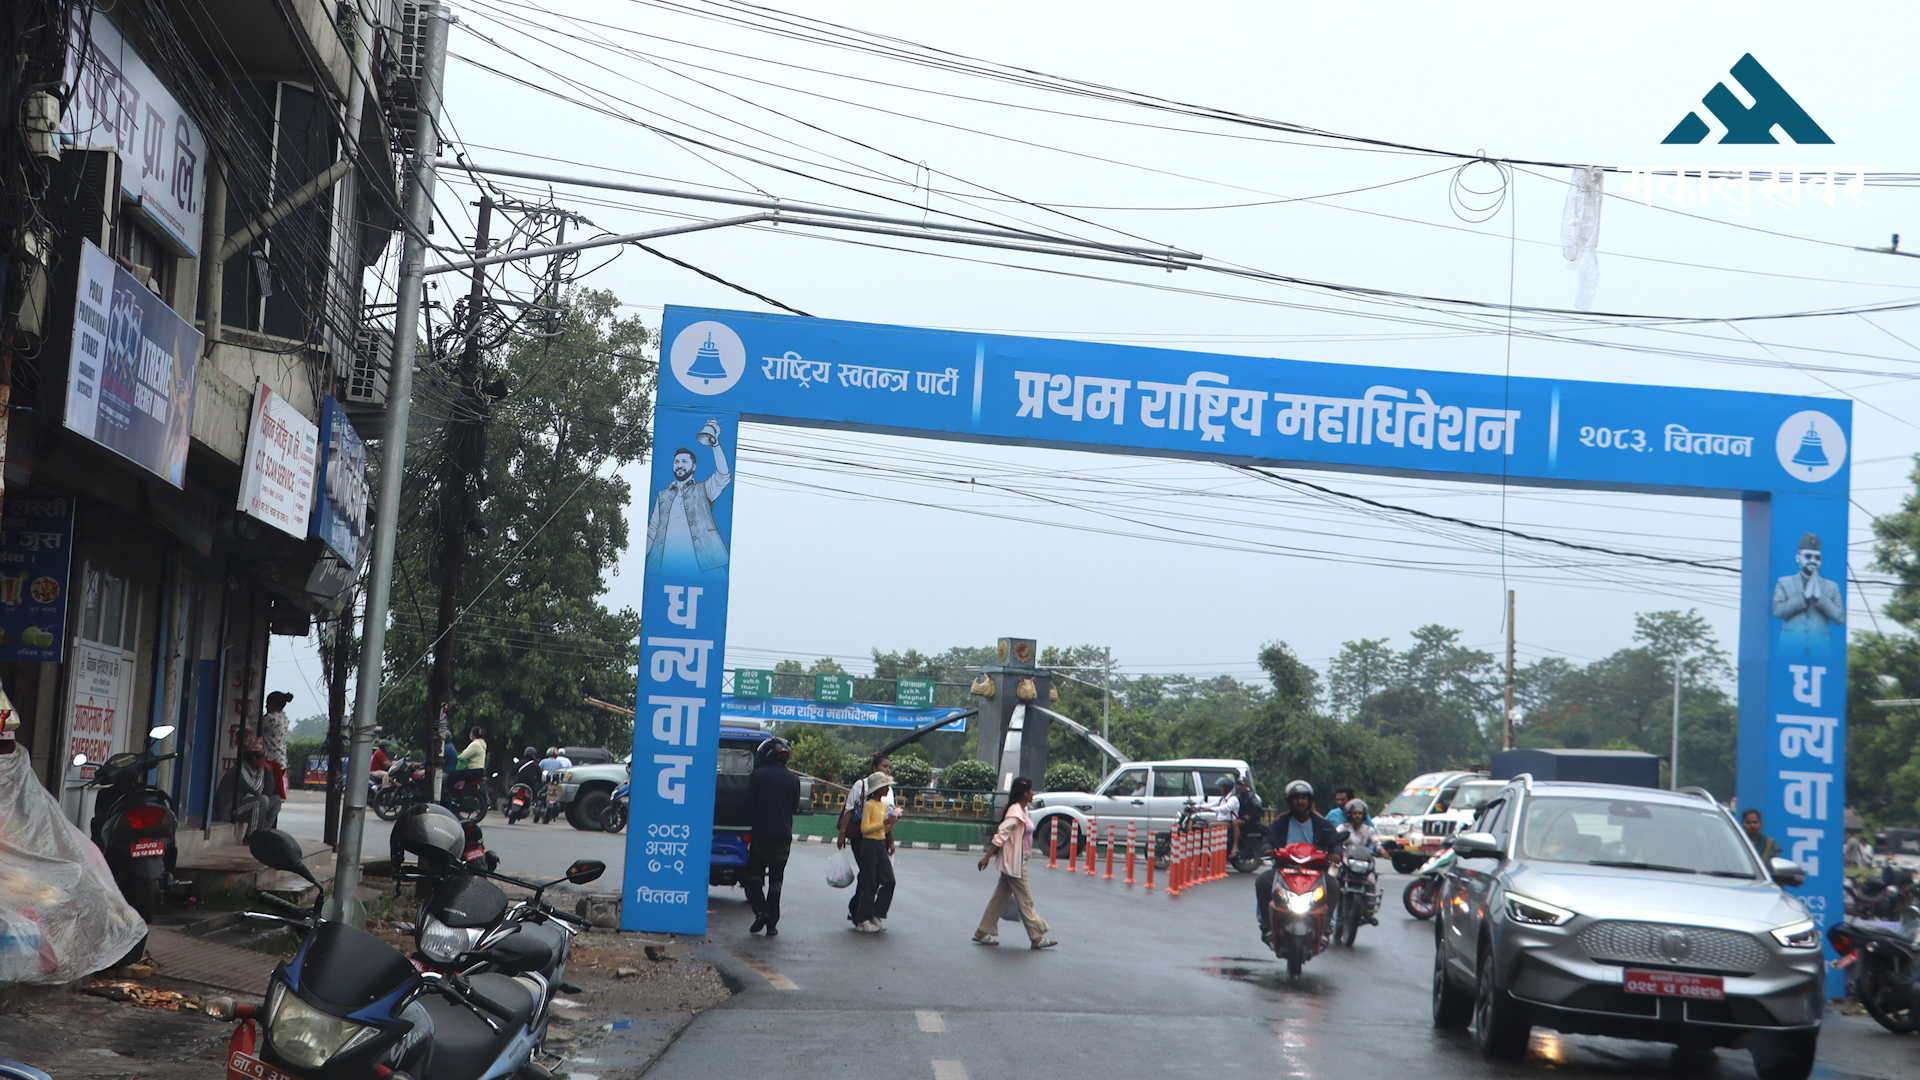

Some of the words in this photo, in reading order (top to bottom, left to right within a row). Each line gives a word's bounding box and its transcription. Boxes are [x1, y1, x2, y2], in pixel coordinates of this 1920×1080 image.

[170, 113, 197, 215] लि.
[78, 300, 108, 337] PROVISIONAL
[81, 333, 100, 360] STORES
[137, 335, 175, 399] XTREME
[762, 351, 831, 389] राष्ट्रिय
[837, 362, 909, 392] स्वतन्त्र
[915, 366, 959, 397] पार्टी
[134, 384, 154, 417] ENERGY
[152, 394, 169, 425] DRINK
[1014, 370, 1129, 425] प्रथम
[1138, 371, 1268, 443] राष्ट्रिय
[1274, 385, 1521, 456] महाधिवेशन
[1663, 423, 1754, 457] चितवन
[266, 455, 277, 486] SCAN
[276, 462, 296, 494] SERVICE
[10, 497, 69, 518] लस्सी
[18, 531, 64, 552] जुस
[771, 704, 796, 717] प्रथम
[826, 708, 879, 723] महाधिवेशन
[70, 736, 113, 765] EMERGENCY
[432, 825, 456, 841] HONDA
[647, 822, 690, 839] २०८३
[645, 840, 688, 857] असार
[636, 886, 690, 906] चितवन
[443, 906, 467, 918] HONDA
